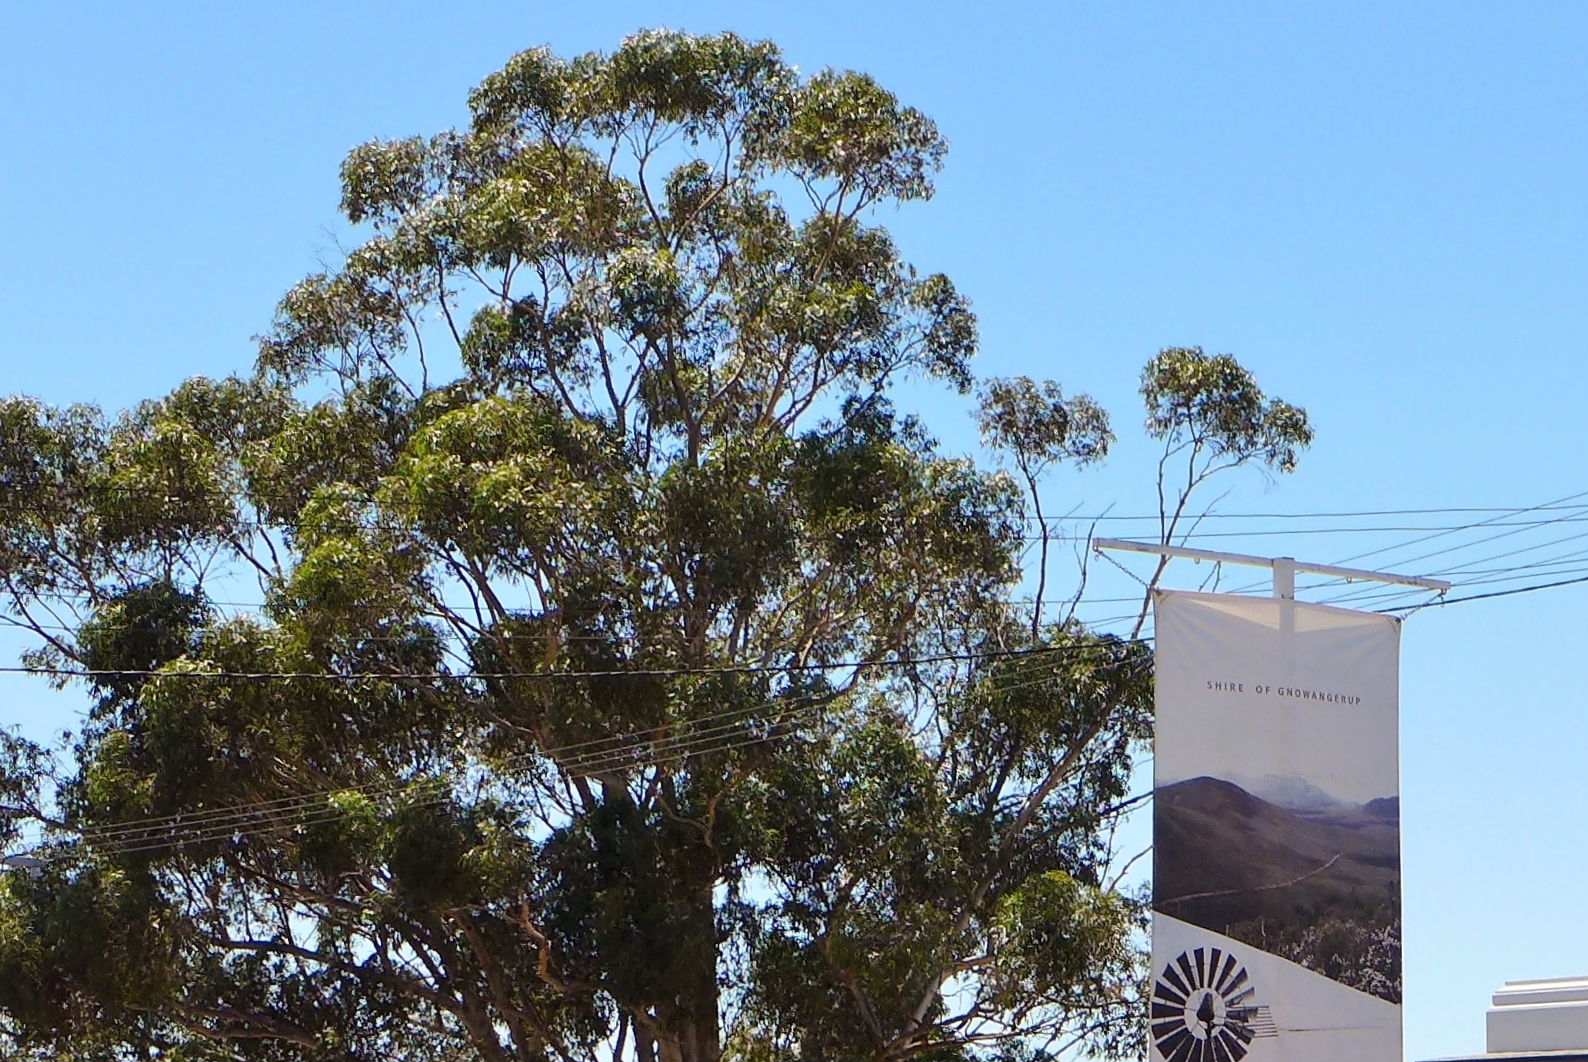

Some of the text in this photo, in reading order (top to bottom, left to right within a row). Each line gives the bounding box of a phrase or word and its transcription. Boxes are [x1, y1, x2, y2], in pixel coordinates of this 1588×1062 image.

[1206, 681, 1361, 706] SHIRE OF GNOWANGERUP
